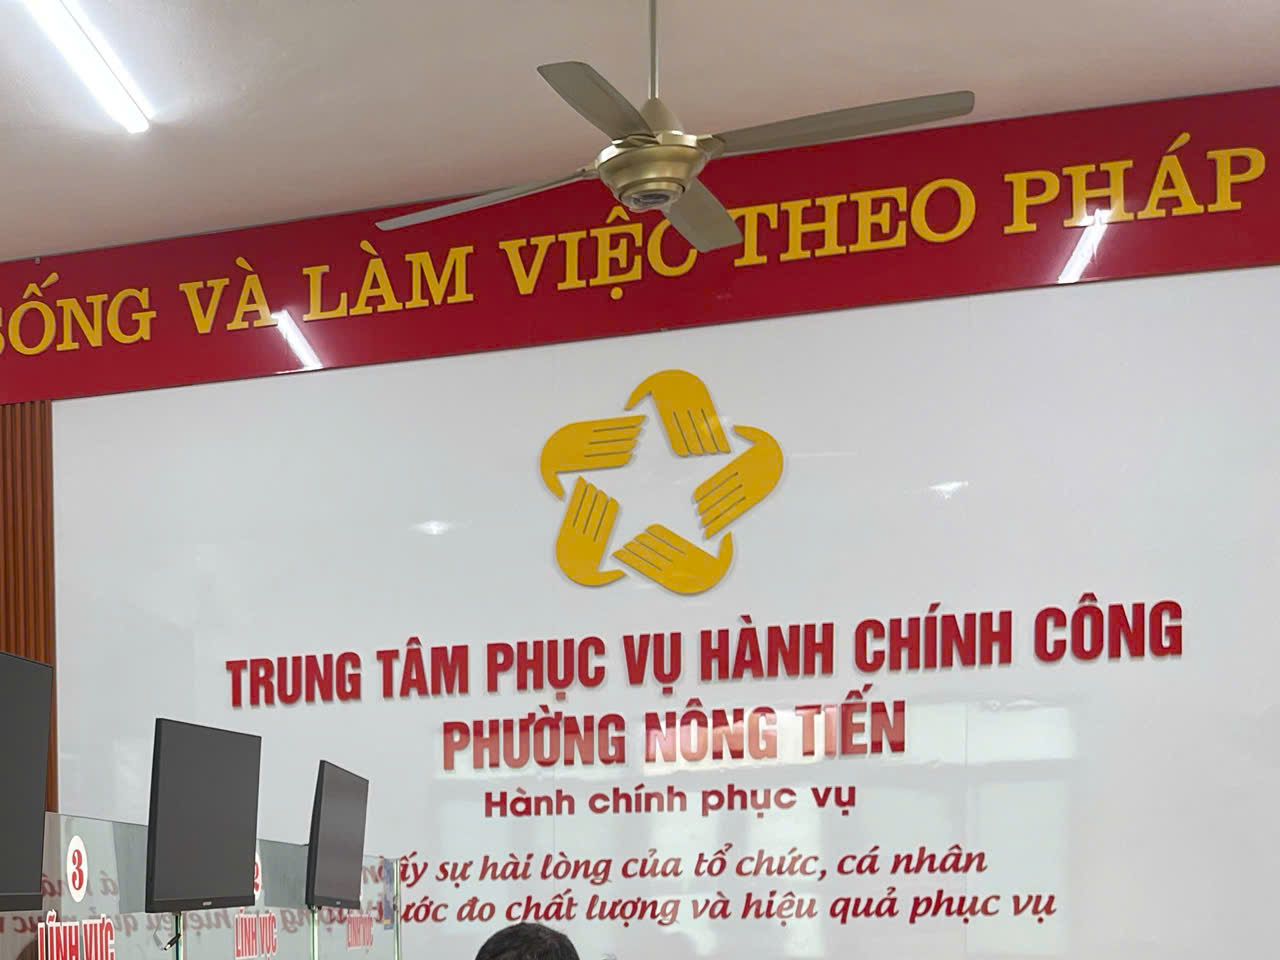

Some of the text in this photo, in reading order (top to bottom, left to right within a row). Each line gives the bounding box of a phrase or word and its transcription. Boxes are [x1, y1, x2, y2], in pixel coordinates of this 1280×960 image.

[179, 257, 281, 334] VÀ
[302, 240, 474, 319] LÀM
[500, 206, 698, 300] VIỆC
[727, 178, 976, 267] THEO
[1004, 132, 1266, 235] PHÁP
[225, 592, 1182, 706] TRUNG TÂM PHỤC VỤ HÀNH CHÍNH CÔNG
[443, 683, 904, 769] PHƯỜNG NÔNG TIẾN
[485, 784, 855, 817] Hành chính phục vụ
[72, 849, 83, 890] 3
[400, 843, 984, 887] ấy sự hài lòng của tổ chức, cá nhân
[401, 887, 1054, 926] ước đo chất lượng và hiệu quả phục vụ
[235, 908, 257, 957] LĨNH
